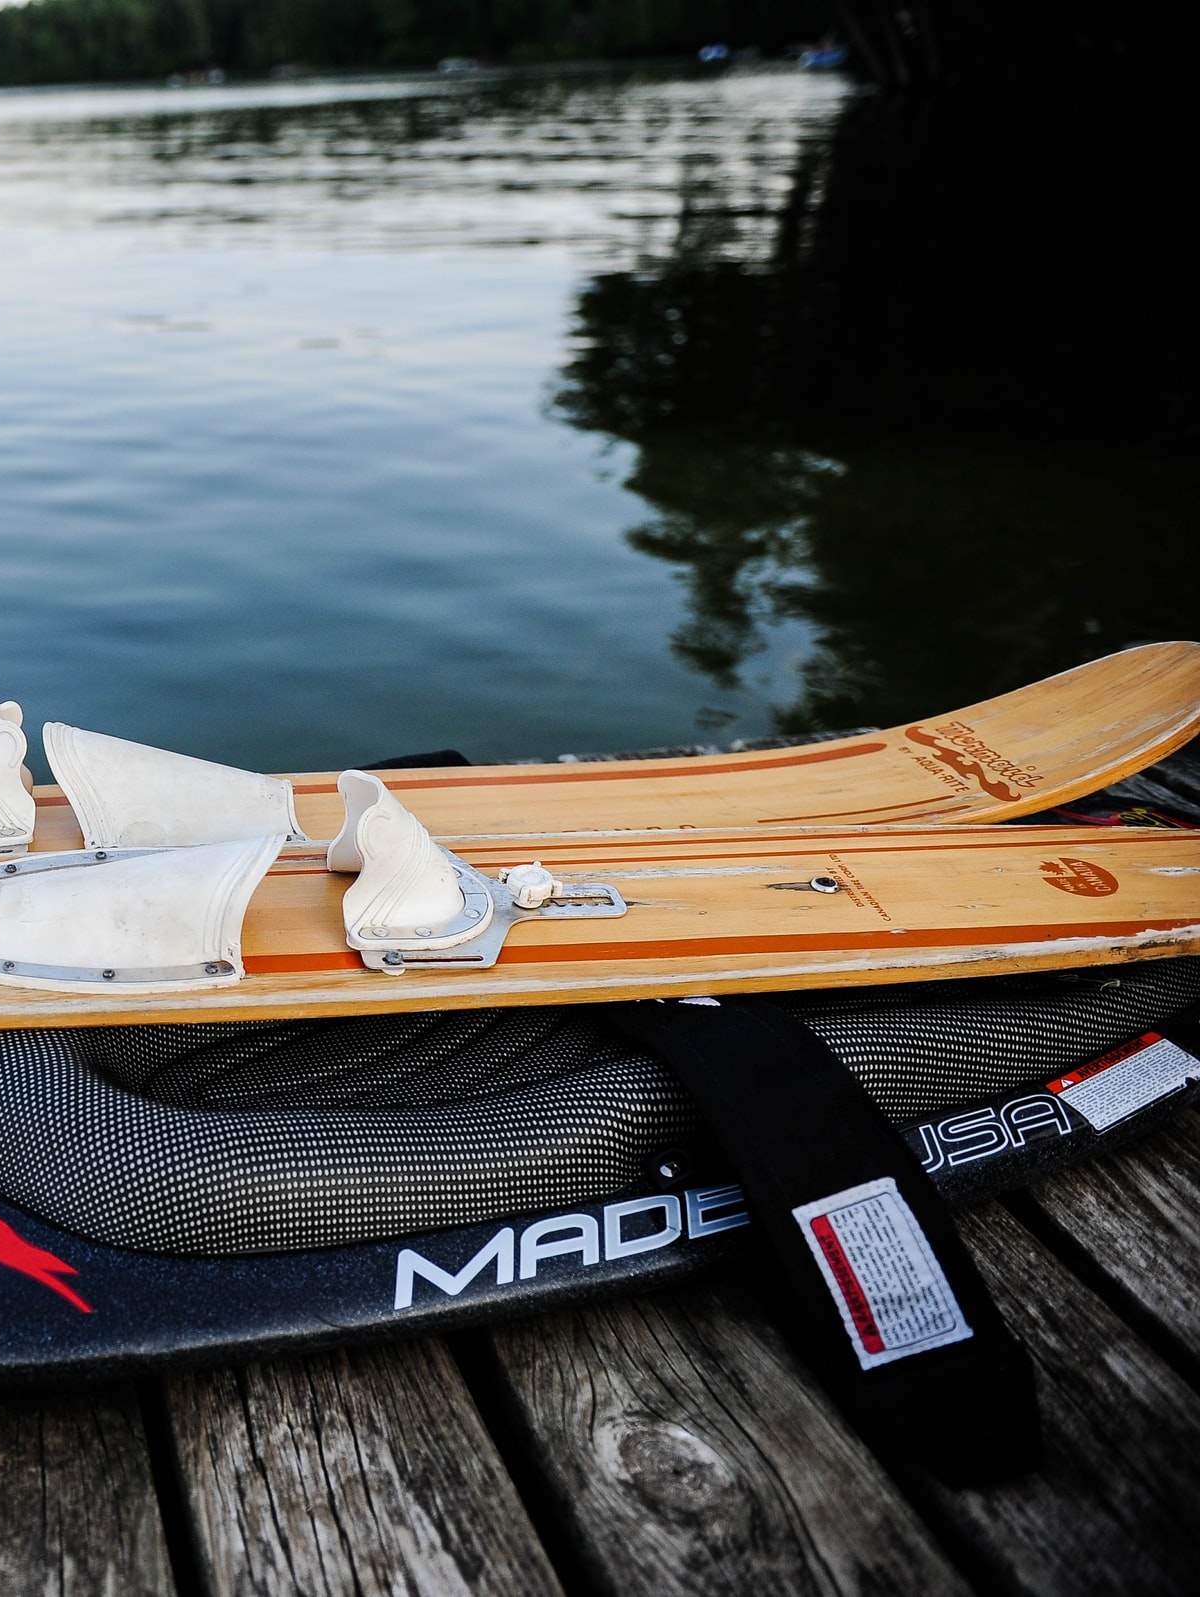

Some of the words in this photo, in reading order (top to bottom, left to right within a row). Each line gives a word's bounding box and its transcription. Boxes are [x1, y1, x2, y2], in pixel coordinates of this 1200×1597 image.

[899, 746, 913, 754] BY
[936, 721, 1044, 788] Mermaid
[851, 879, 864, 890] TIRE
[1069, 861, 1112, 892] CANADA
[861, 891, 892, 921] CANADIAN
[394, 1184, 750, 1311] MADE
